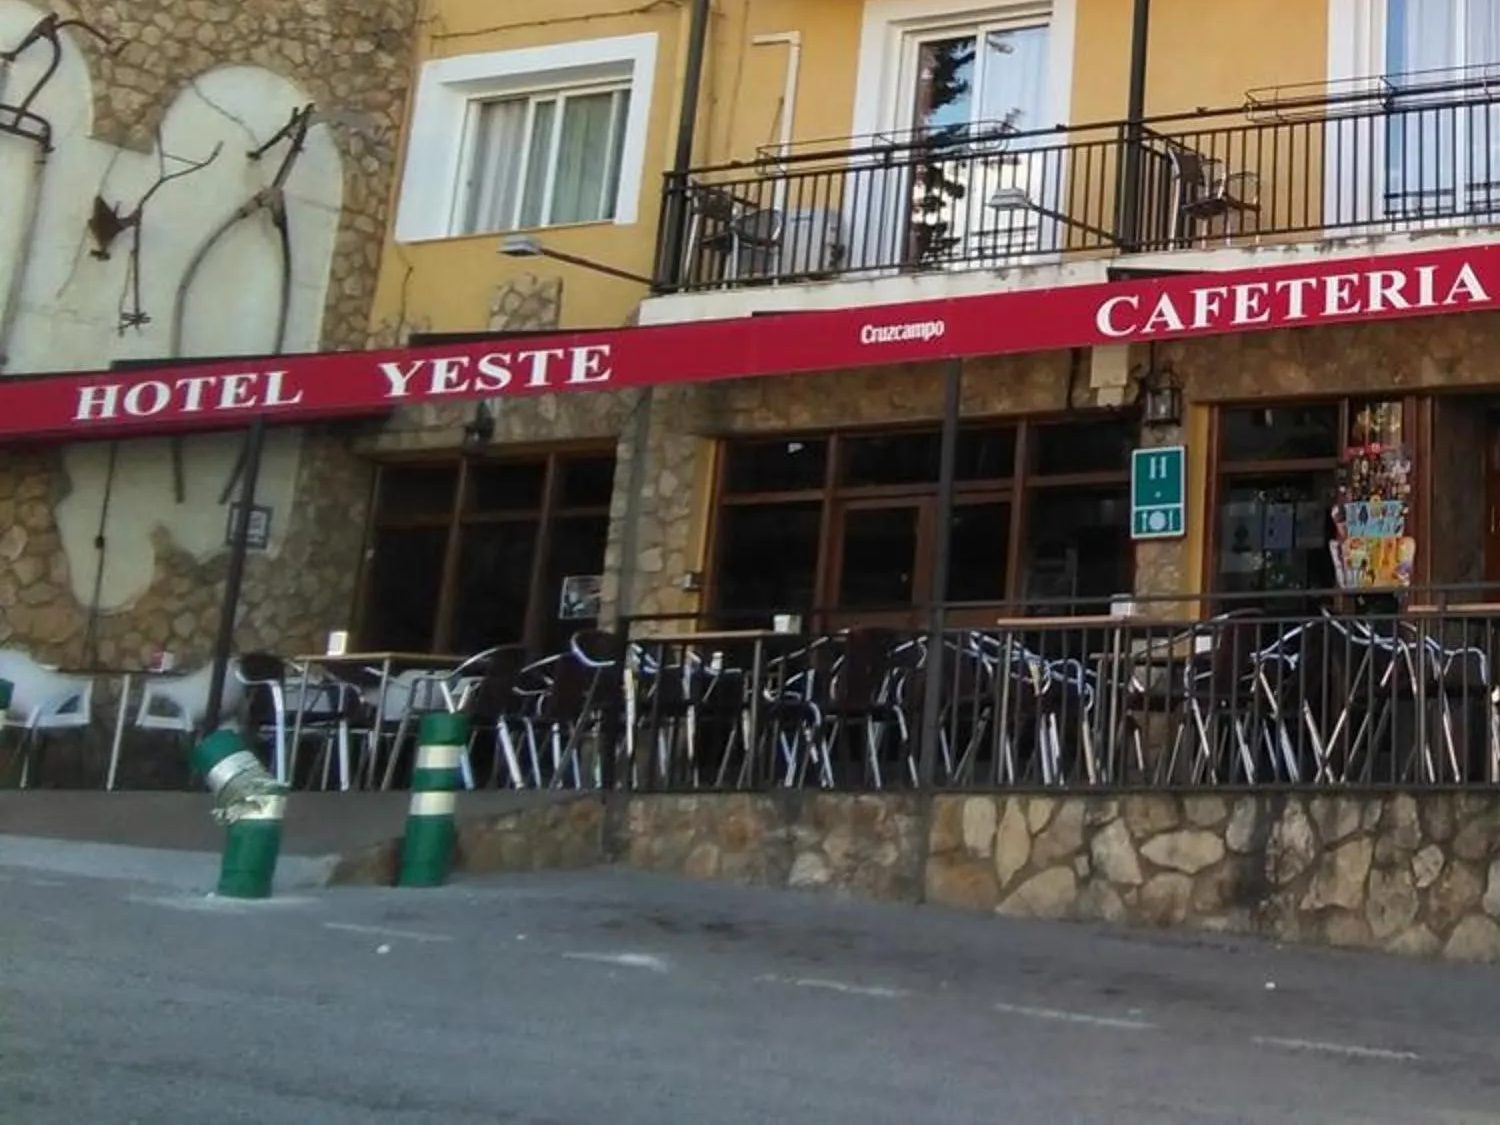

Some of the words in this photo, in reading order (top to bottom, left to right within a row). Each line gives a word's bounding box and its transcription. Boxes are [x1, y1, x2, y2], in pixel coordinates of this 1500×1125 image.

[1095, 262, 1491, 338] CAFETERIA
[861, 320, 945, 344] Cruzcampo
[73, 370, 304, 420] HOTEL
[379, 344, 612, 398] YESTE
[1149, 456, 1167, 480] H
